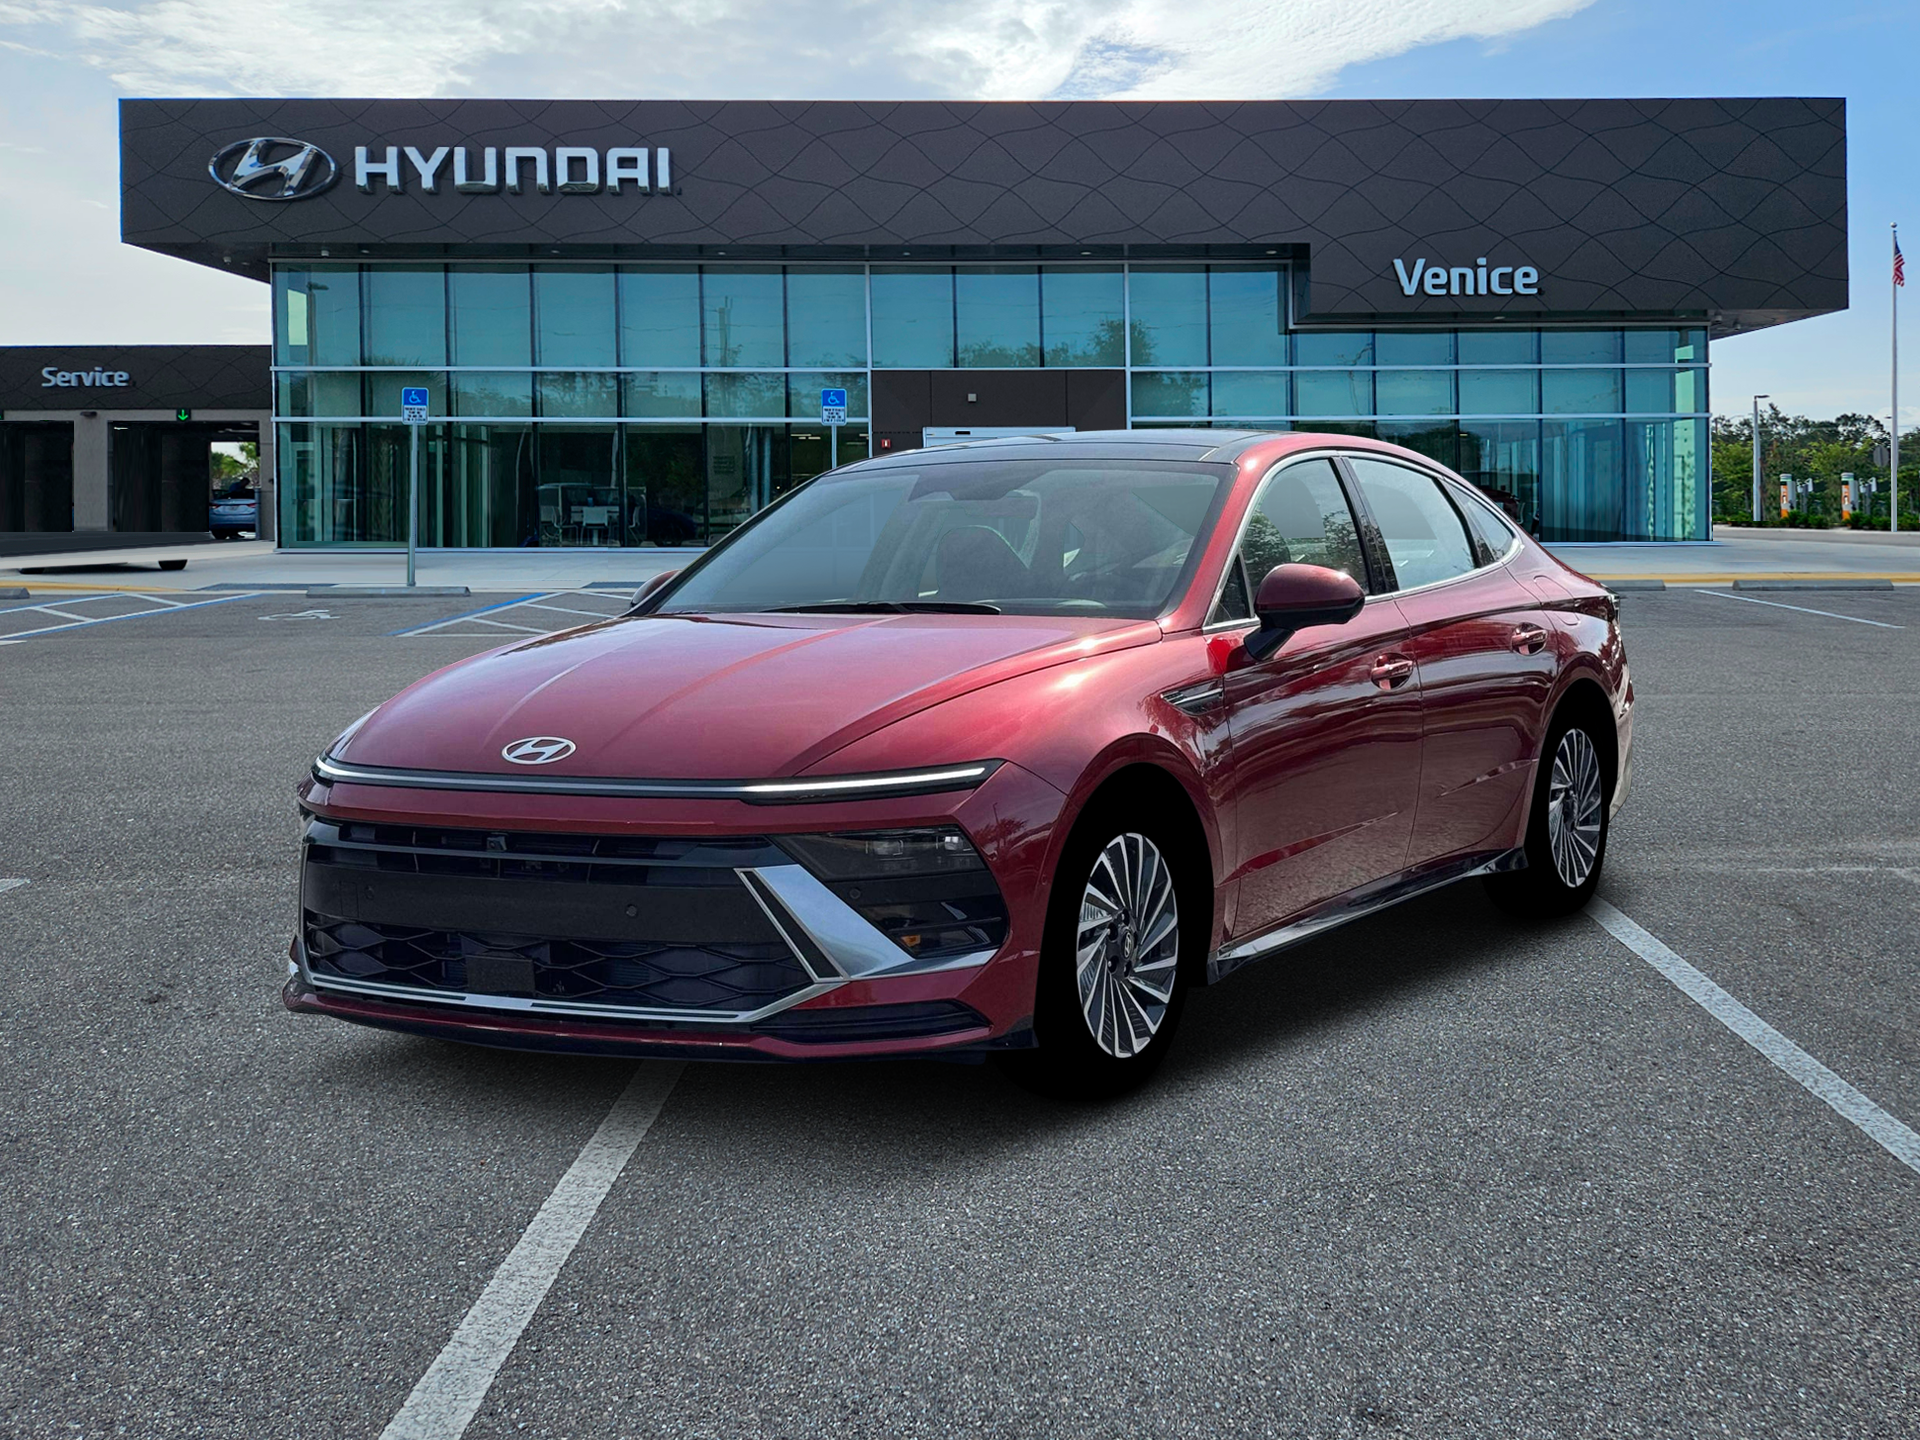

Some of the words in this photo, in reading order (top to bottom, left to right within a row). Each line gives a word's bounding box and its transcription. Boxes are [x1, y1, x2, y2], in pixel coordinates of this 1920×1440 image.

[354, 146, 671, 193] HYUNDAI
[1393, 257, 1539, 296] Venice
[41, 366, 130, 387] Service
